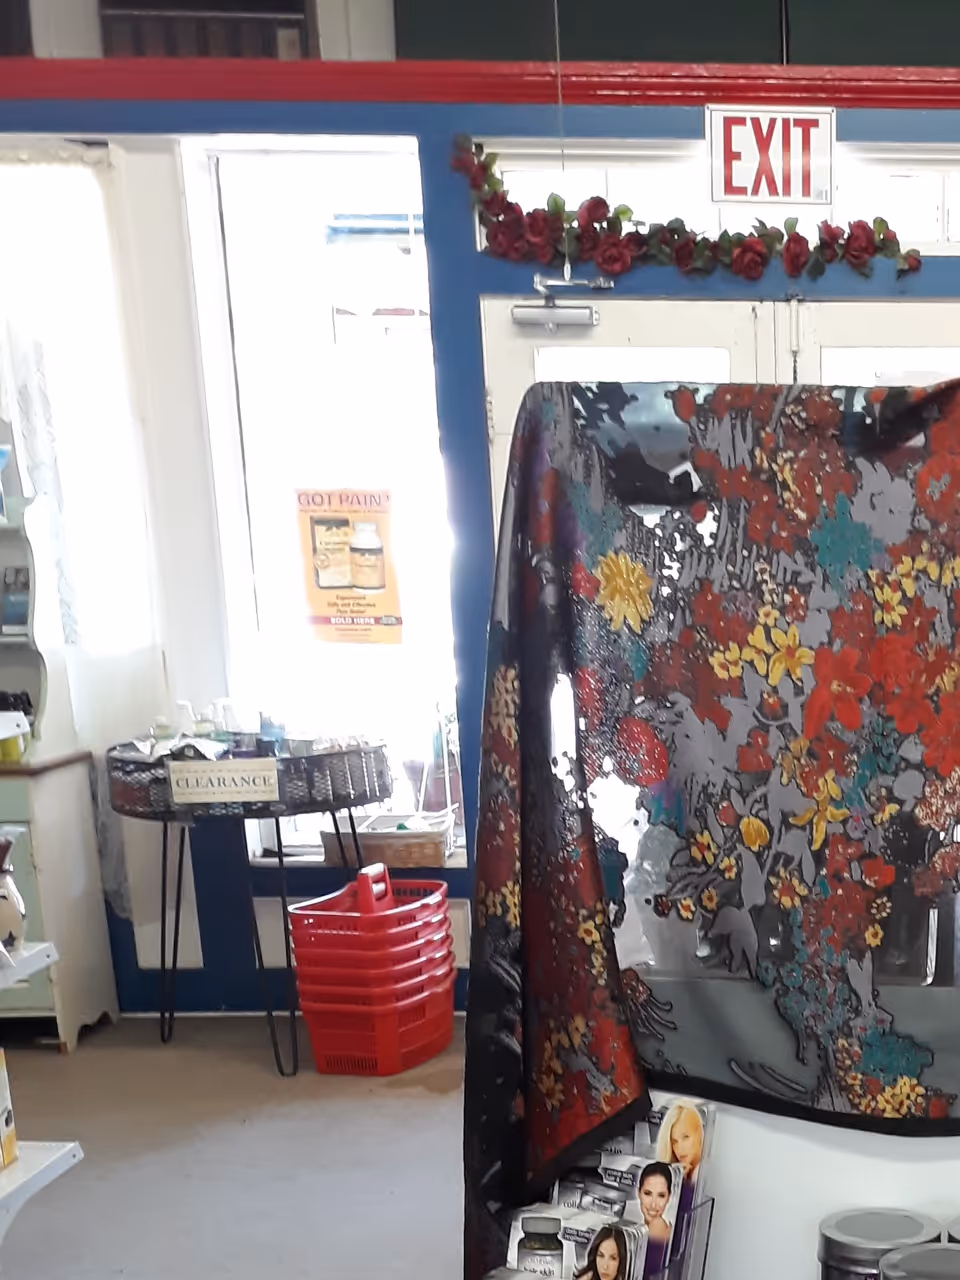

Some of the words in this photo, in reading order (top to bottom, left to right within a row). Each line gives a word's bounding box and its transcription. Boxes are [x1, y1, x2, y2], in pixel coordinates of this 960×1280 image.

[722, 116, 820, 198] EXIT
[298, 492, 332, 507] GOT
[175, 775, 273, 790] CLEARANCE
